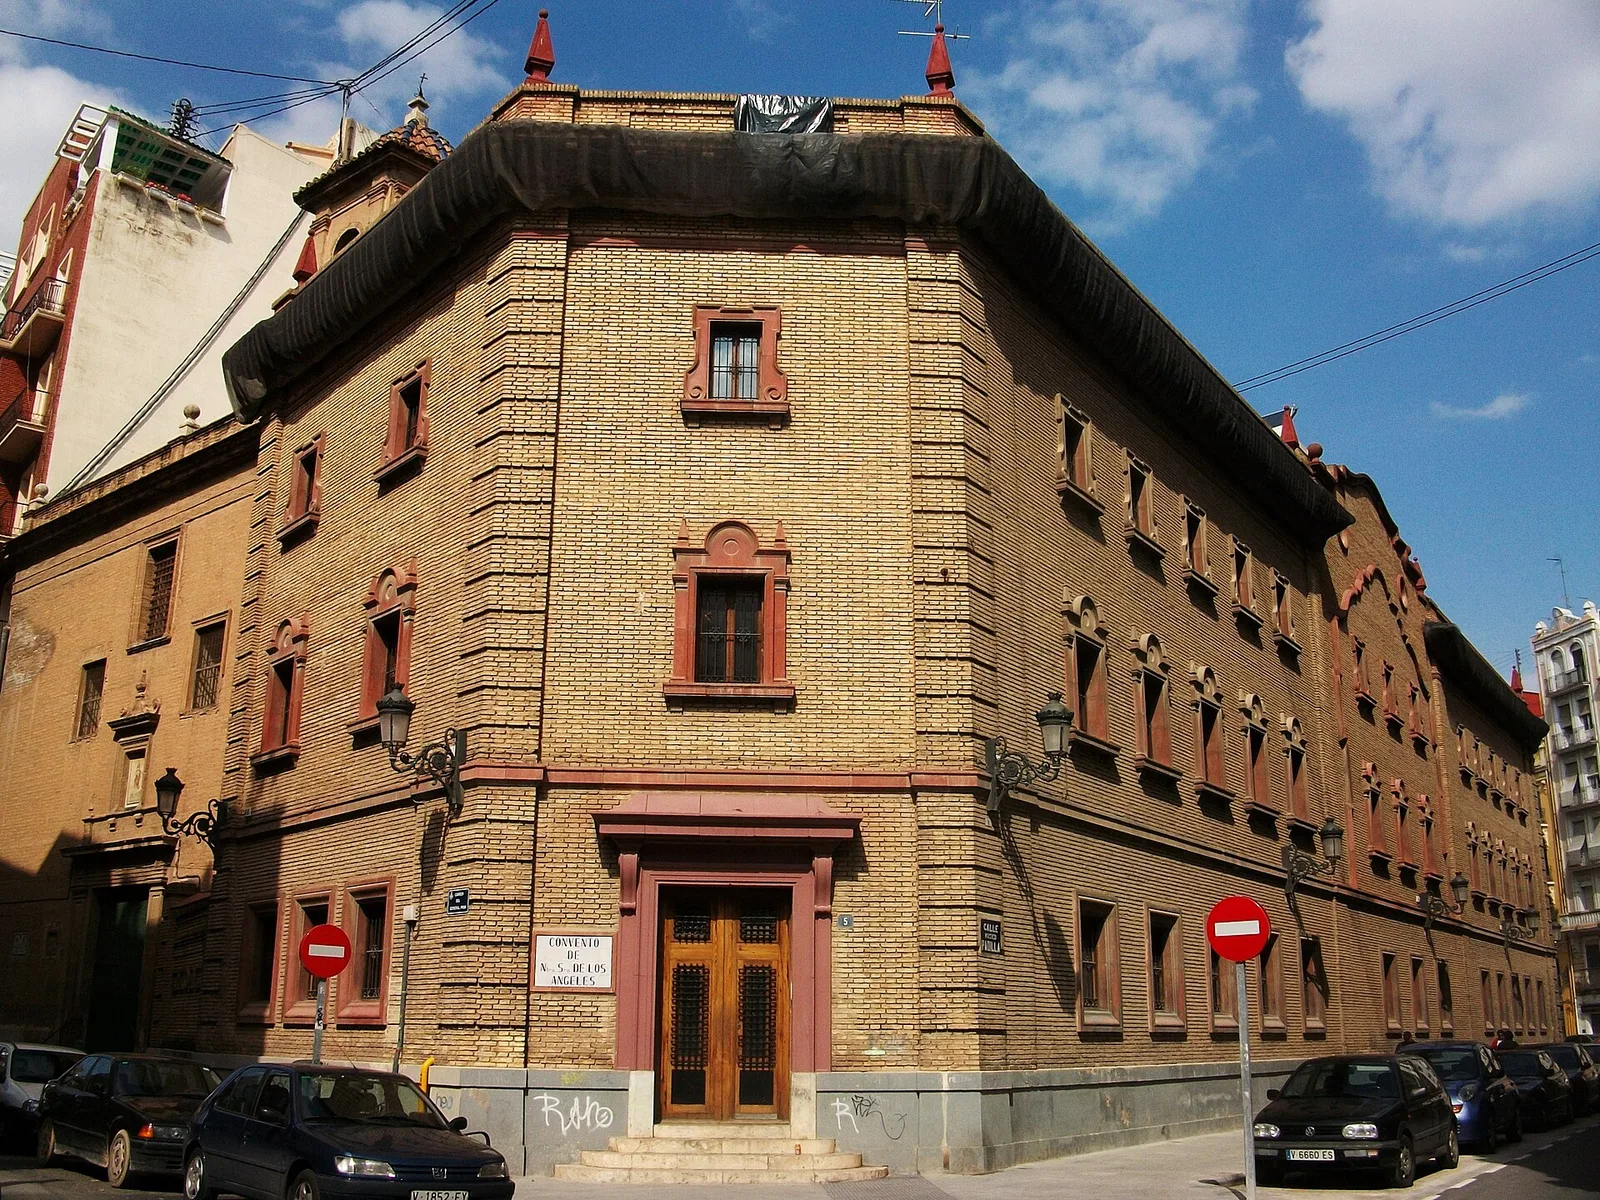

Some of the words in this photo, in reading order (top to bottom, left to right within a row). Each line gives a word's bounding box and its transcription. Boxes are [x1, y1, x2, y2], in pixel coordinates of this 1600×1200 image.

[983, 922, 999, 933] CALLE
[549, 937, 600, 948] CONVENTO
[567, 950, 580, 960] DE
[573, 963, 585, 973] DE
[588, 963, 606, 973] LOS
[551, 975, 596, 986] ANGELES
[1299, 1151, 1320, 1159] 6660
[1322, 1151, 1333, 1159] ES
